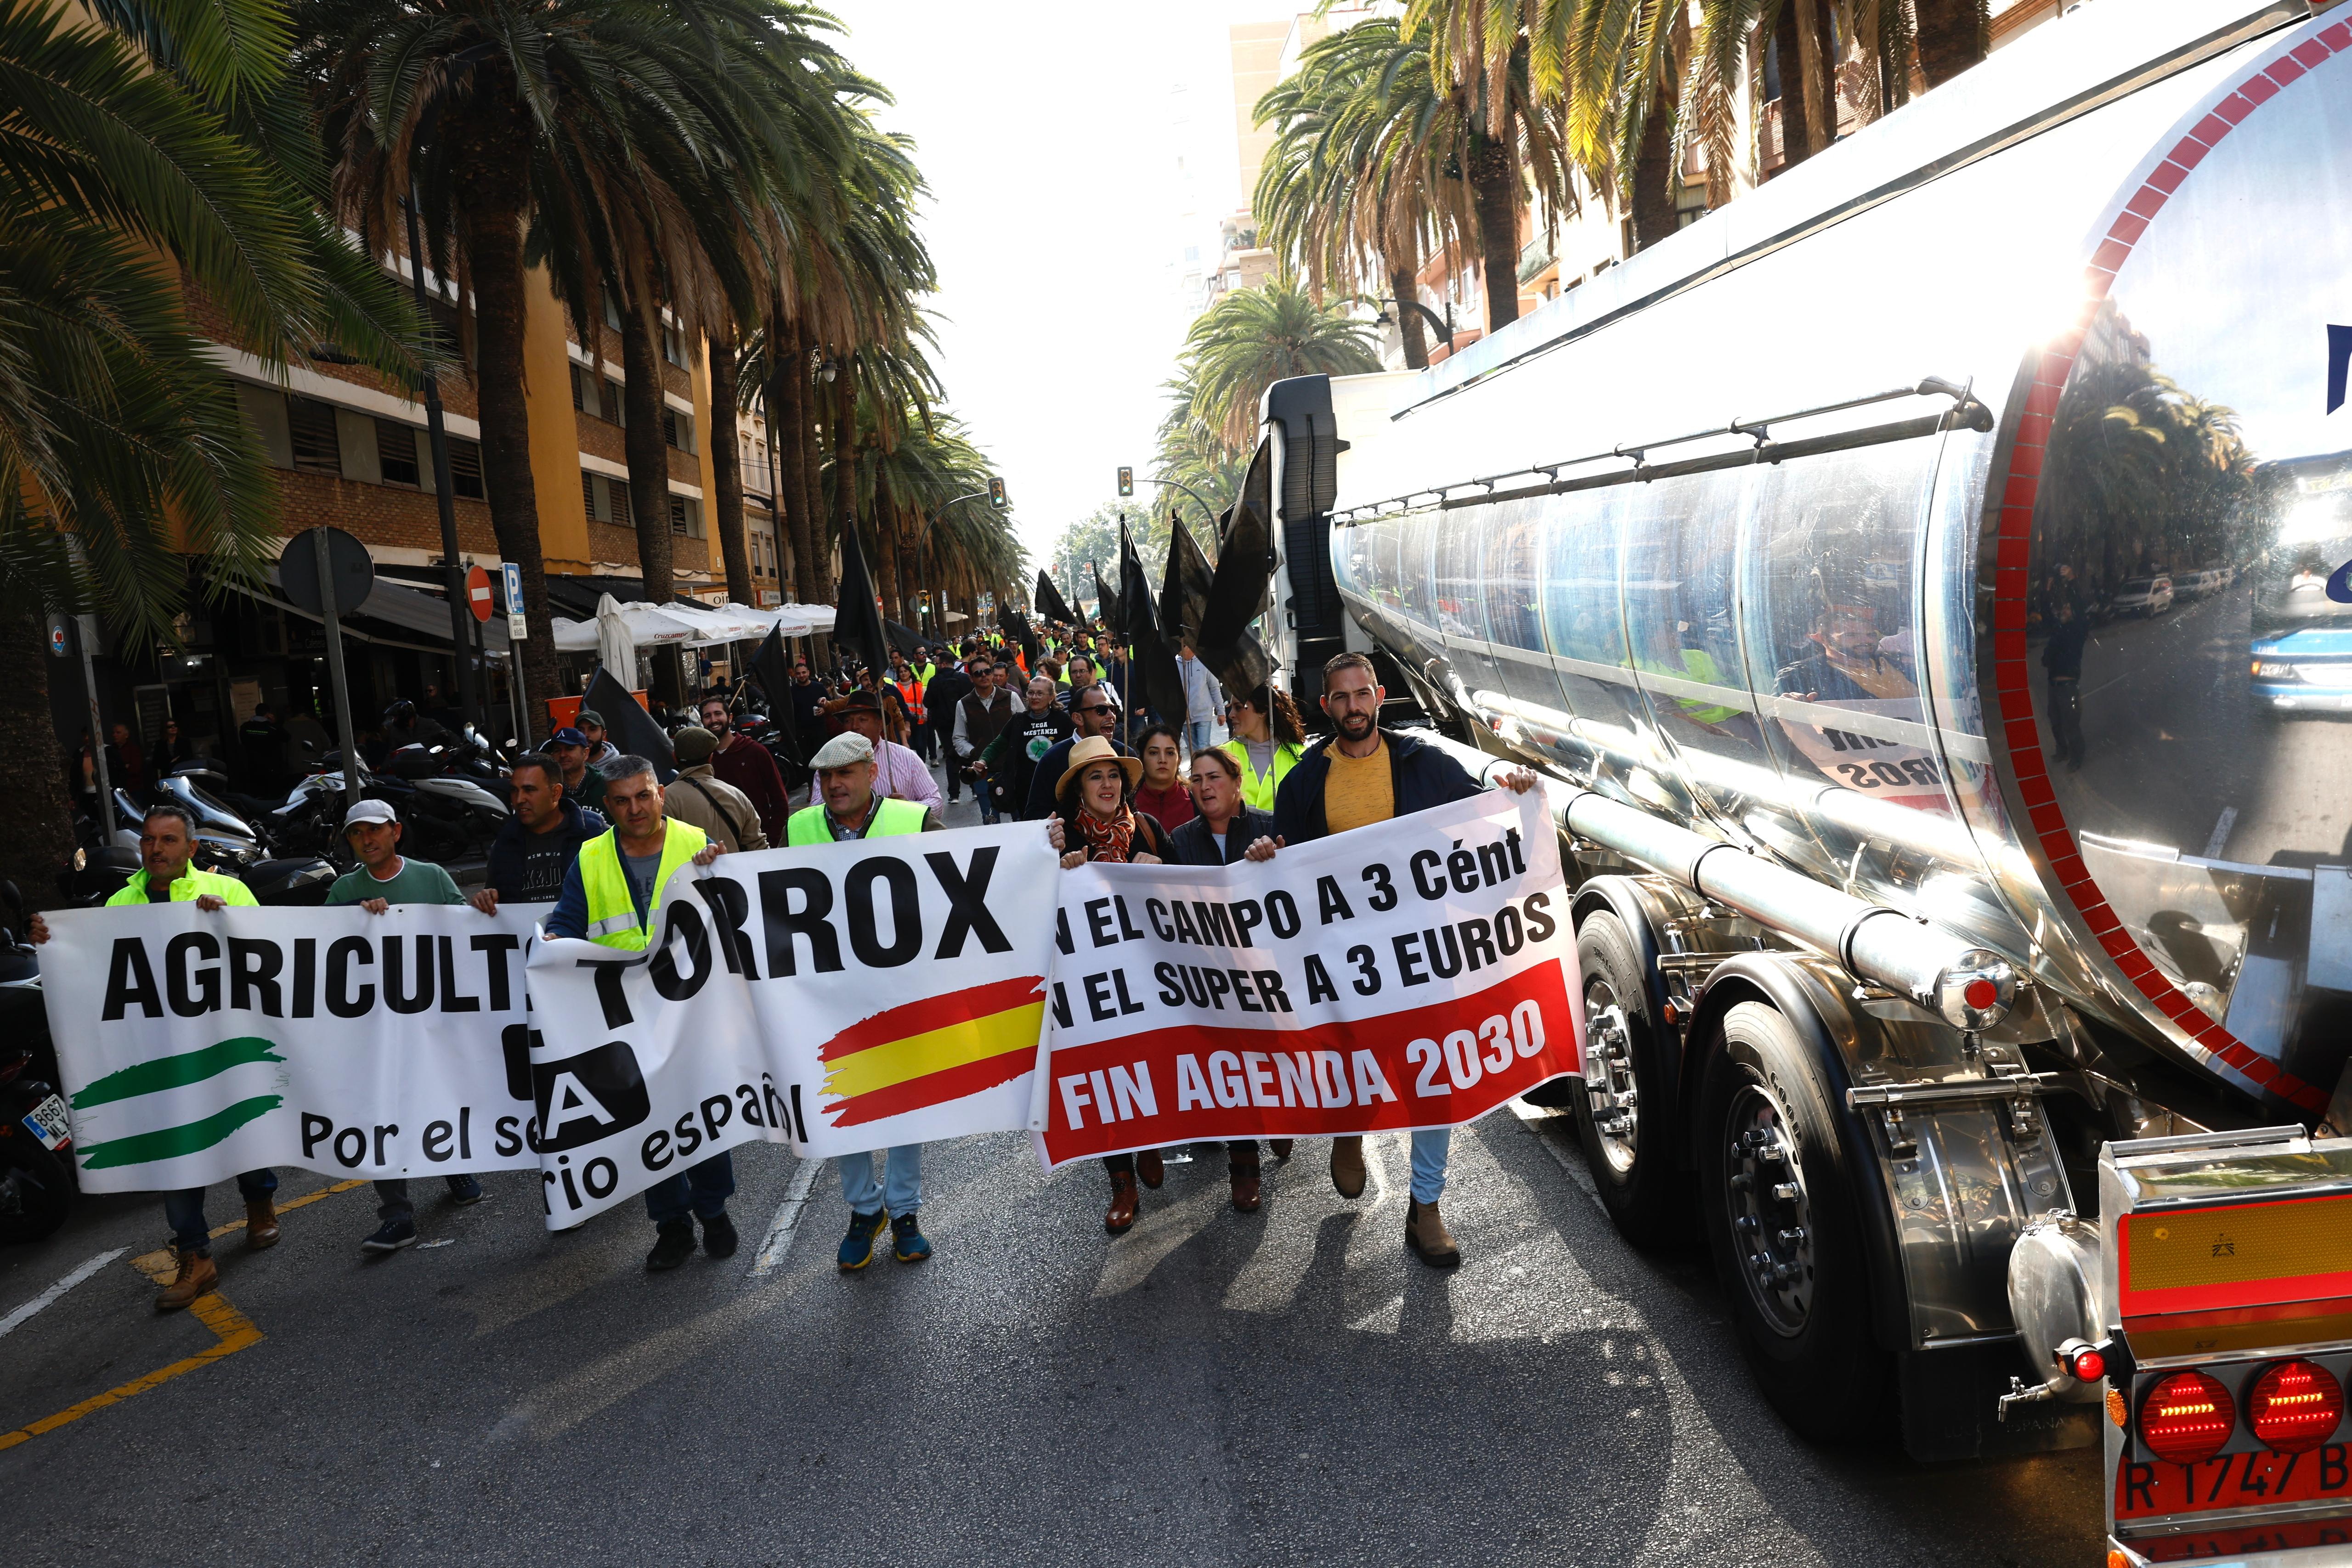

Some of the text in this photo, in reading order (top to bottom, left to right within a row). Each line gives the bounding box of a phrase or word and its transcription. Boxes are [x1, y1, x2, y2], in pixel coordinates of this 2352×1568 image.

[508, 570, 519, 607] P
[1084, 894, 1146, 948] EL
[1145, 889, 1301, 949] CAMPO
[1317, 874, 1354, 925] A
[1362, 863, 1398, 912] 3
[1410, 826, 1527, 901] Cént
[101, 931, 533, 1021] AGRICULT
[577, 846, 1013, 1030] TORROX
[1083, 968, 1145, 1022] EL
[1154, 961, 1293, 1014] SUPER
[1304, 953, 1340, 1005] A
[1347, 944, 1382, 997] 3
[1394, 891, 1556, 987] EUROS
[1057, 998, 1546, 1130] FIN AGENDA 2030
[35, 1099, 63, 1127] 8667
[46, 1116, 70, 1141] MLX
[301, 1111, 398, 1168] Por
[422, 1107, 472, 1162] el
[641, 1072, 808, 1171] español
[2125, 1463, 2154, 1510] R
[2179, 1453, 2299, 1504] 1747
